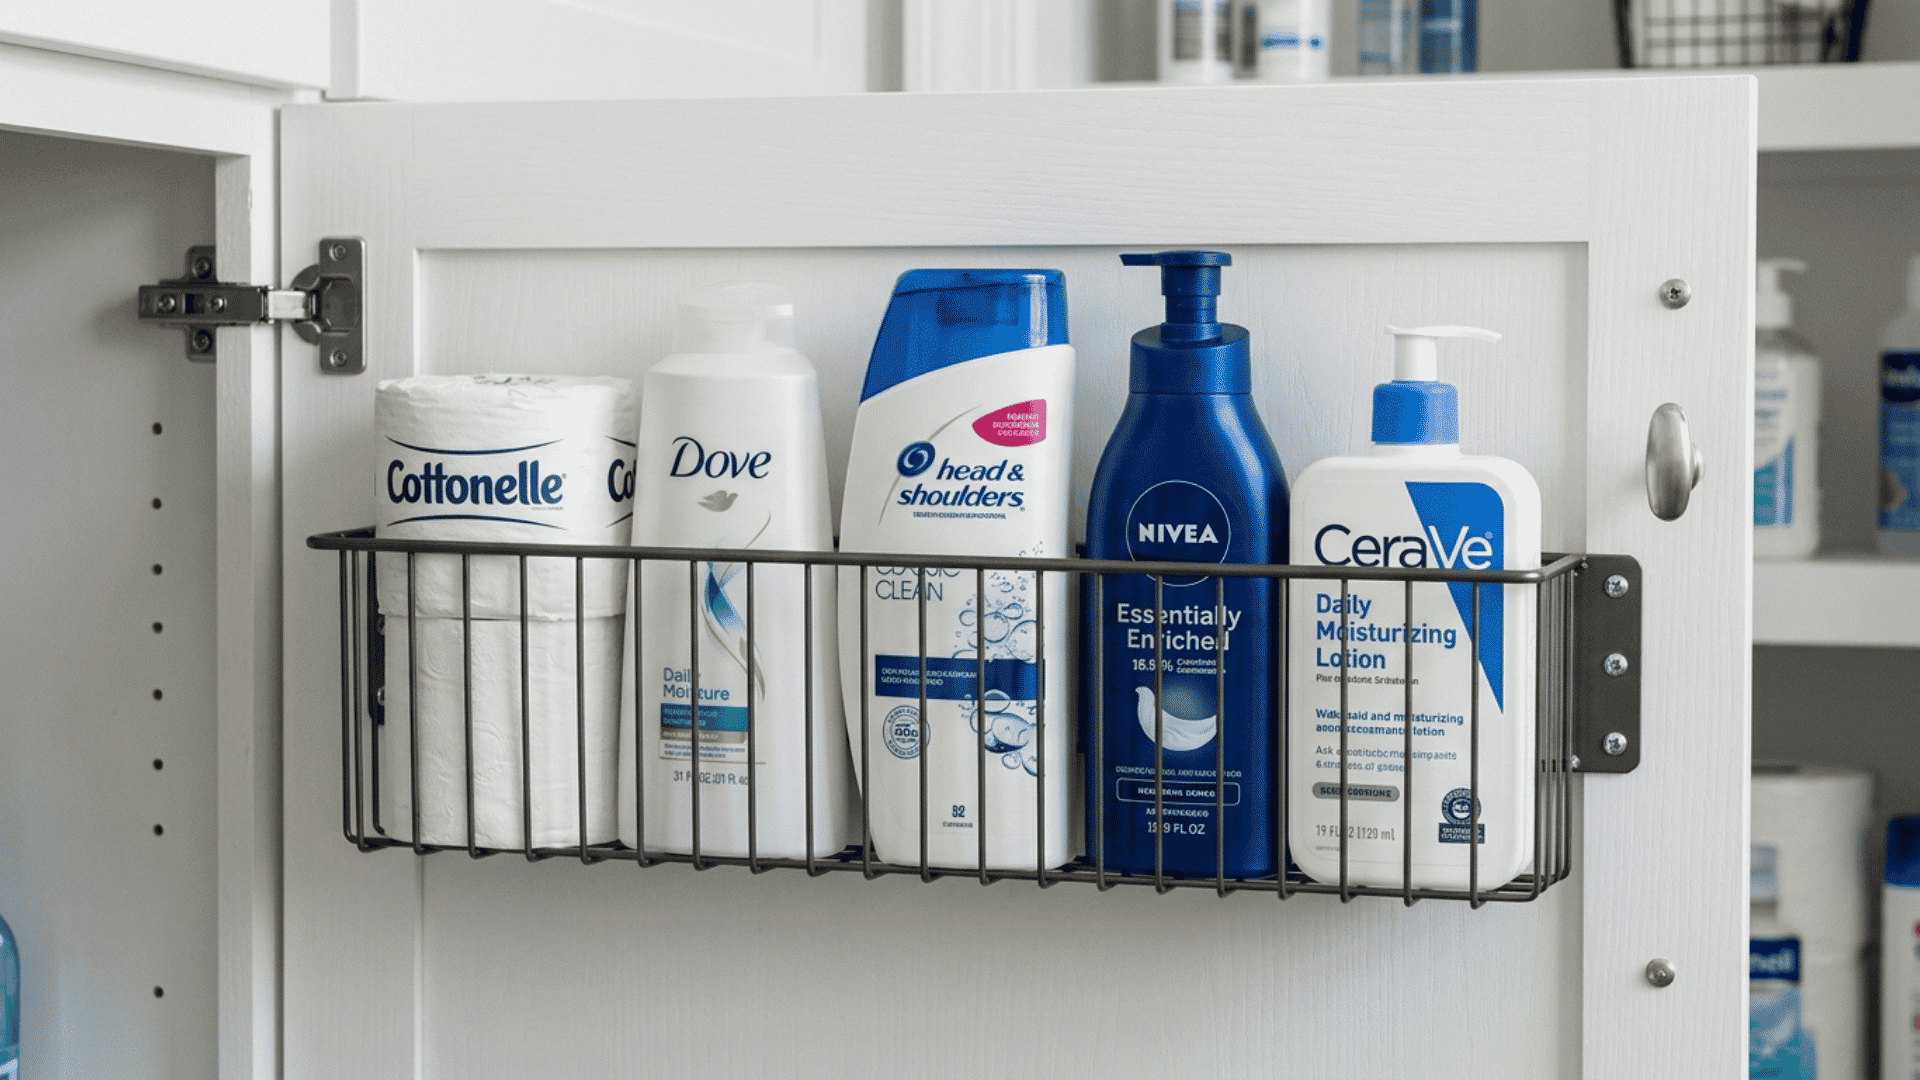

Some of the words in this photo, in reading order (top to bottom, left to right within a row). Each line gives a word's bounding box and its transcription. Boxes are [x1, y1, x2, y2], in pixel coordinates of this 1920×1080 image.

[669, 435, 772, 479] Dove
[936, 457, 1008, 482] head
[1007, 463, 1025, 482] &
[387, 459, 563, 505] Cottonelle
[607, 458, 637, 503] Co
[897, 483, 1025, 507] shoulders
[1138, 522, 1219, 544] NIVEA
[1314, 523, 1493, 570] CeraVe
[1117, 602, 1242, 631] Essentially
[1316, 593, 1372, 619] Daily
[1316, 620, 1457, 649] Moisturizing
[1316, 647, 1386, 669] Lotion
